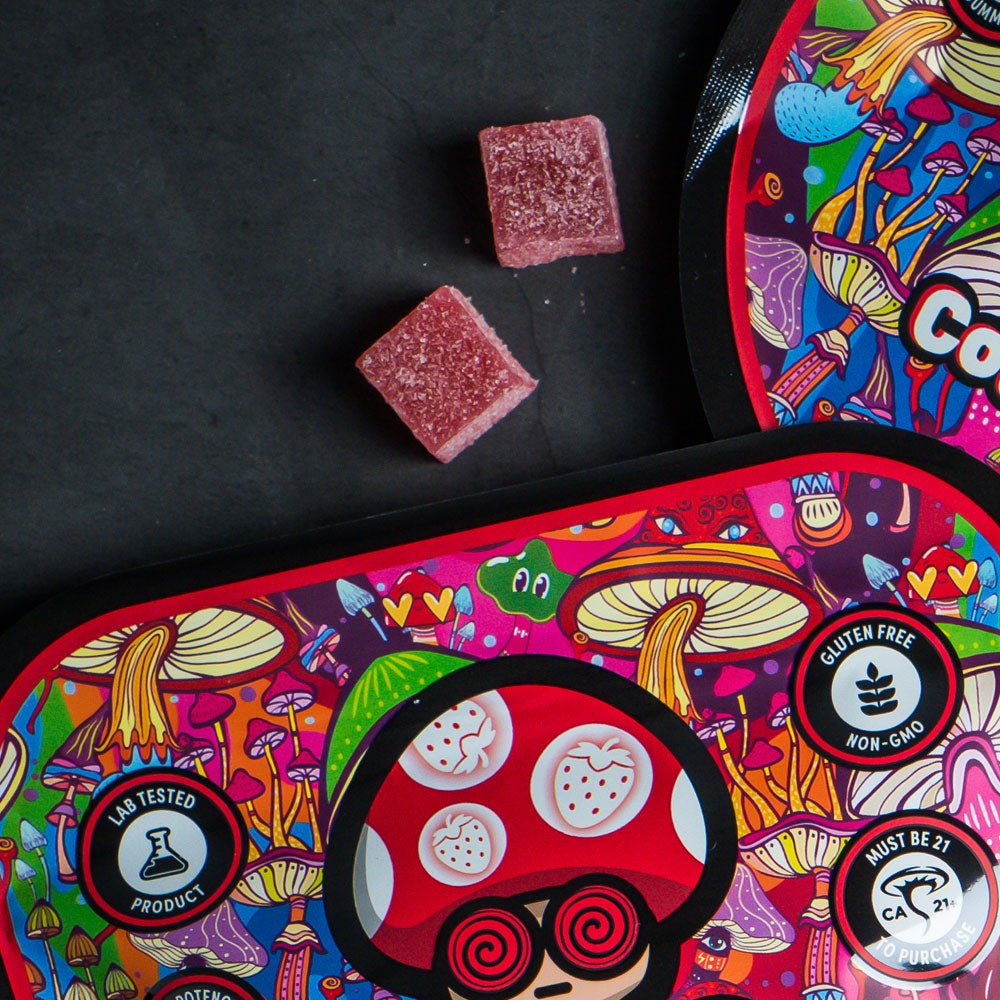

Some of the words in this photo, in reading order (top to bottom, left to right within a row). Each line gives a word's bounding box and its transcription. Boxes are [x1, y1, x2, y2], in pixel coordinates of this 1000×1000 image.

[820, 625, 874, 666] GLUTEN
[877, 624, 916, 650] FREE
[846, 720, 925, 751] NON-GMO
[108, 798, 138, 826] LAB
[136, 788, 196, 810] TESTED
[865, 832, 906, 867] MUST
[910, 830, 931, 847] BE
[932, 835, 951, 854] 21
[131, 884, 206, 914] PRODUCT
[881, 905, 908, 922] CA
[875, 935, 896, 958] TO
[898, 921, 977, 966] PURCHASE
